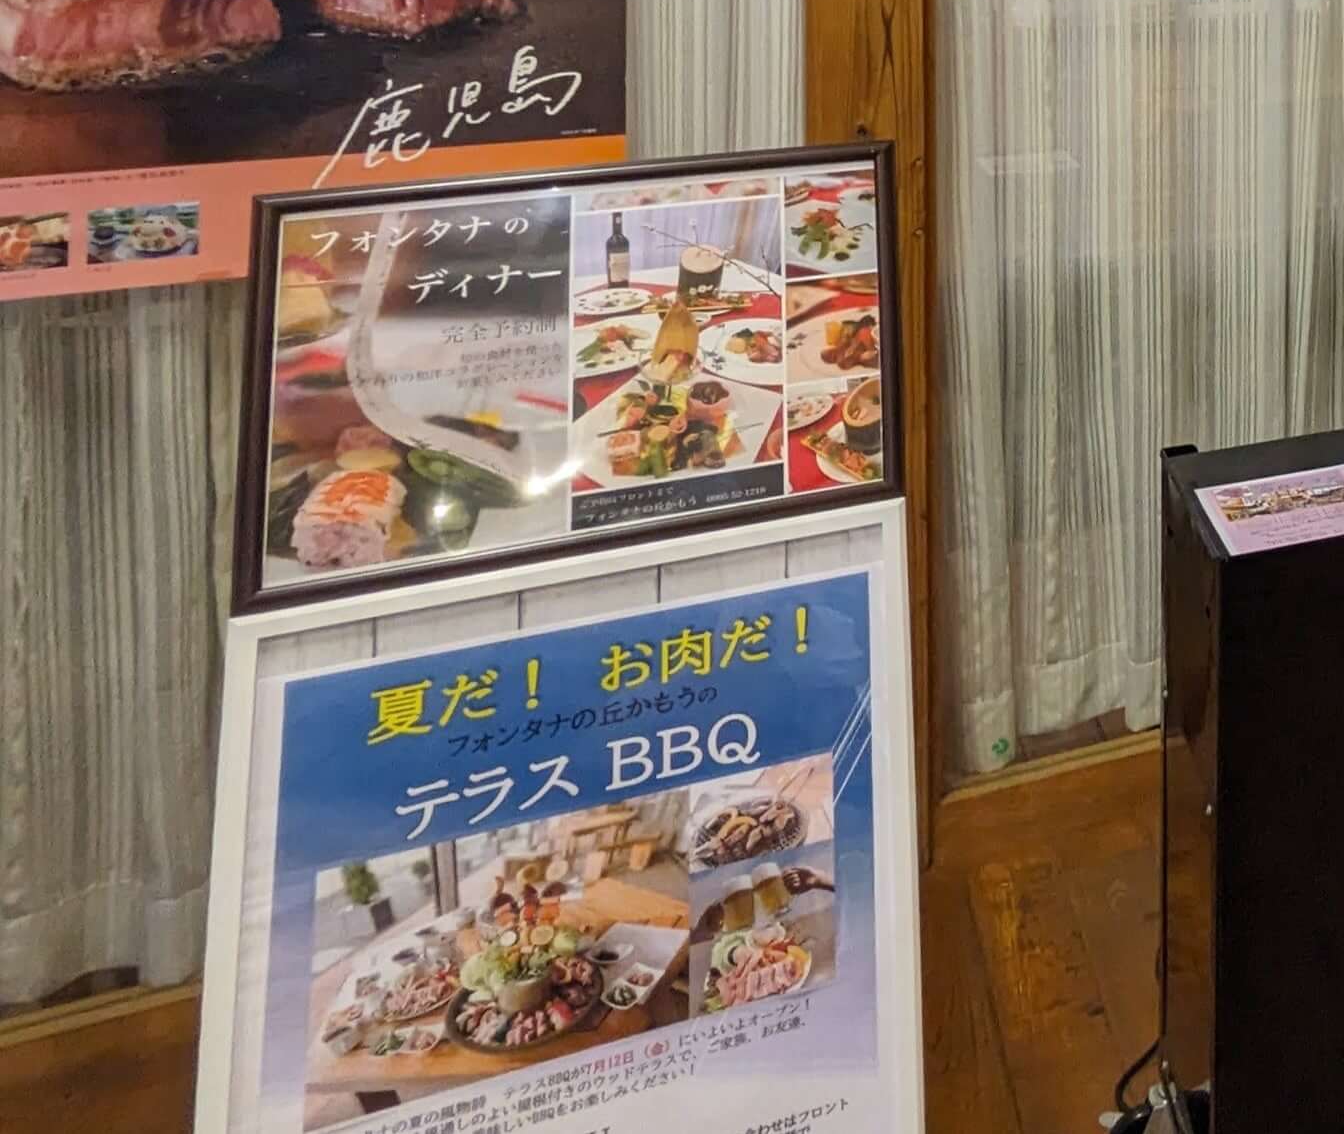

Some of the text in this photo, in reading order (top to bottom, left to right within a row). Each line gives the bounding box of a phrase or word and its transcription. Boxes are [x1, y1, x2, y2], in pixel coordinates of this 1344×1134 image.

[312, 45, 582, 190] 鹿児島
[311, 216, 529, 258] フォンタナの
[407, 265, 562, 304] ディナー
[367, 607, 810, 746] 夏だ！ お肉だ！
[447, 684, 718, 758] フォンタナの丘かもうの
[395, 713, 761, 841] テラス BBQ
